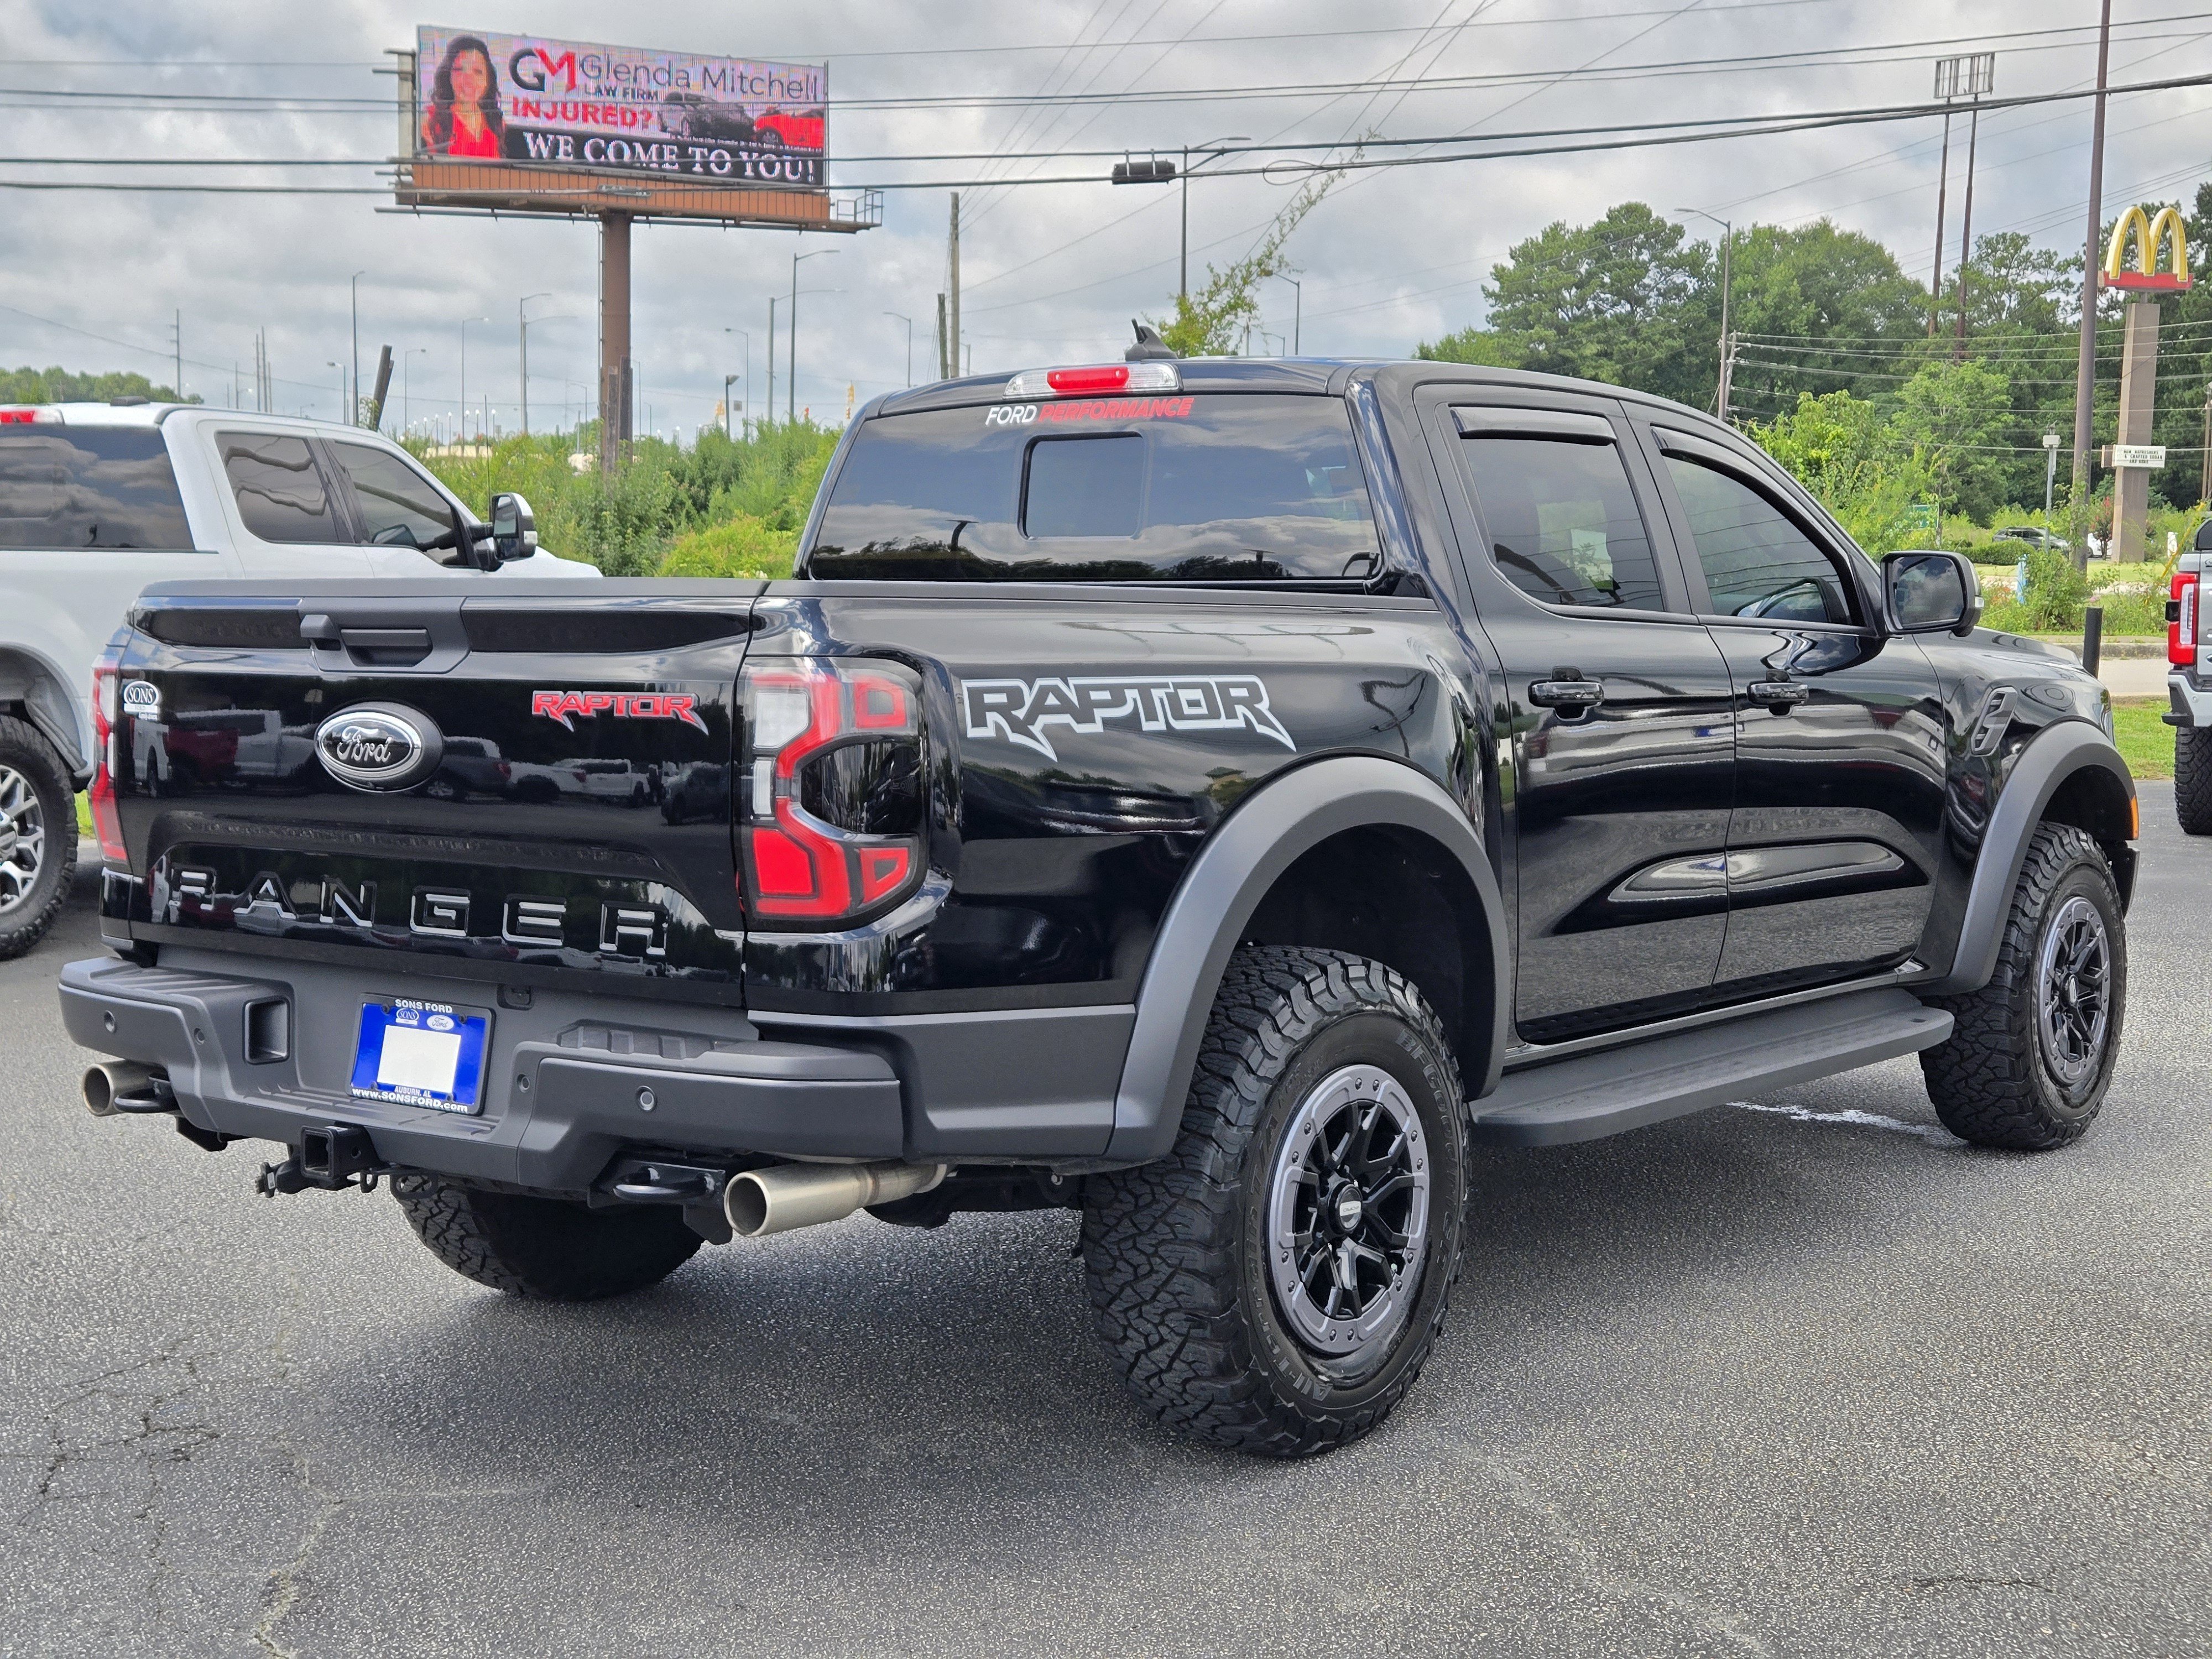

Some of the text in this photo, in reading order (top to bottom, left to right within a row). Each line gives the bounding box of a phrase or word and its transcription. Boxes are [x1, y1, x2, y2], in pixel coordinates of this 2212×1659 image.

[509, 48, 576, 93] GM
[581, 53, 817, 101] Glenda Mitchell
[585, 84, 658, 101] LAW FIRM
[512, 95, 653, 129] INJURED?
[523, 131, 574, 161] WE
[584, 138, 679, 170] COME
[688, 147, 731, 174] TO
[739, 150, 814, 182] YOU!
[985, 398, 1195, 426] FORD PERFORMANCE
[128, 687, 154, 704] SONS
[532, 691, 709, 736] RAPTOR
[961, 675, 1296, 762] RAPTOR
[336, 725, 392, 763] Ford
[169, 866, 669, 956] RANGER
[395, 999, 453, 1013] SONS FORD
[399, 1010, 415, 1020] SONS
[431, 1016, 449, 1028] Ford
[352, 1088, 468, 1113] www.SONSFORD.com
